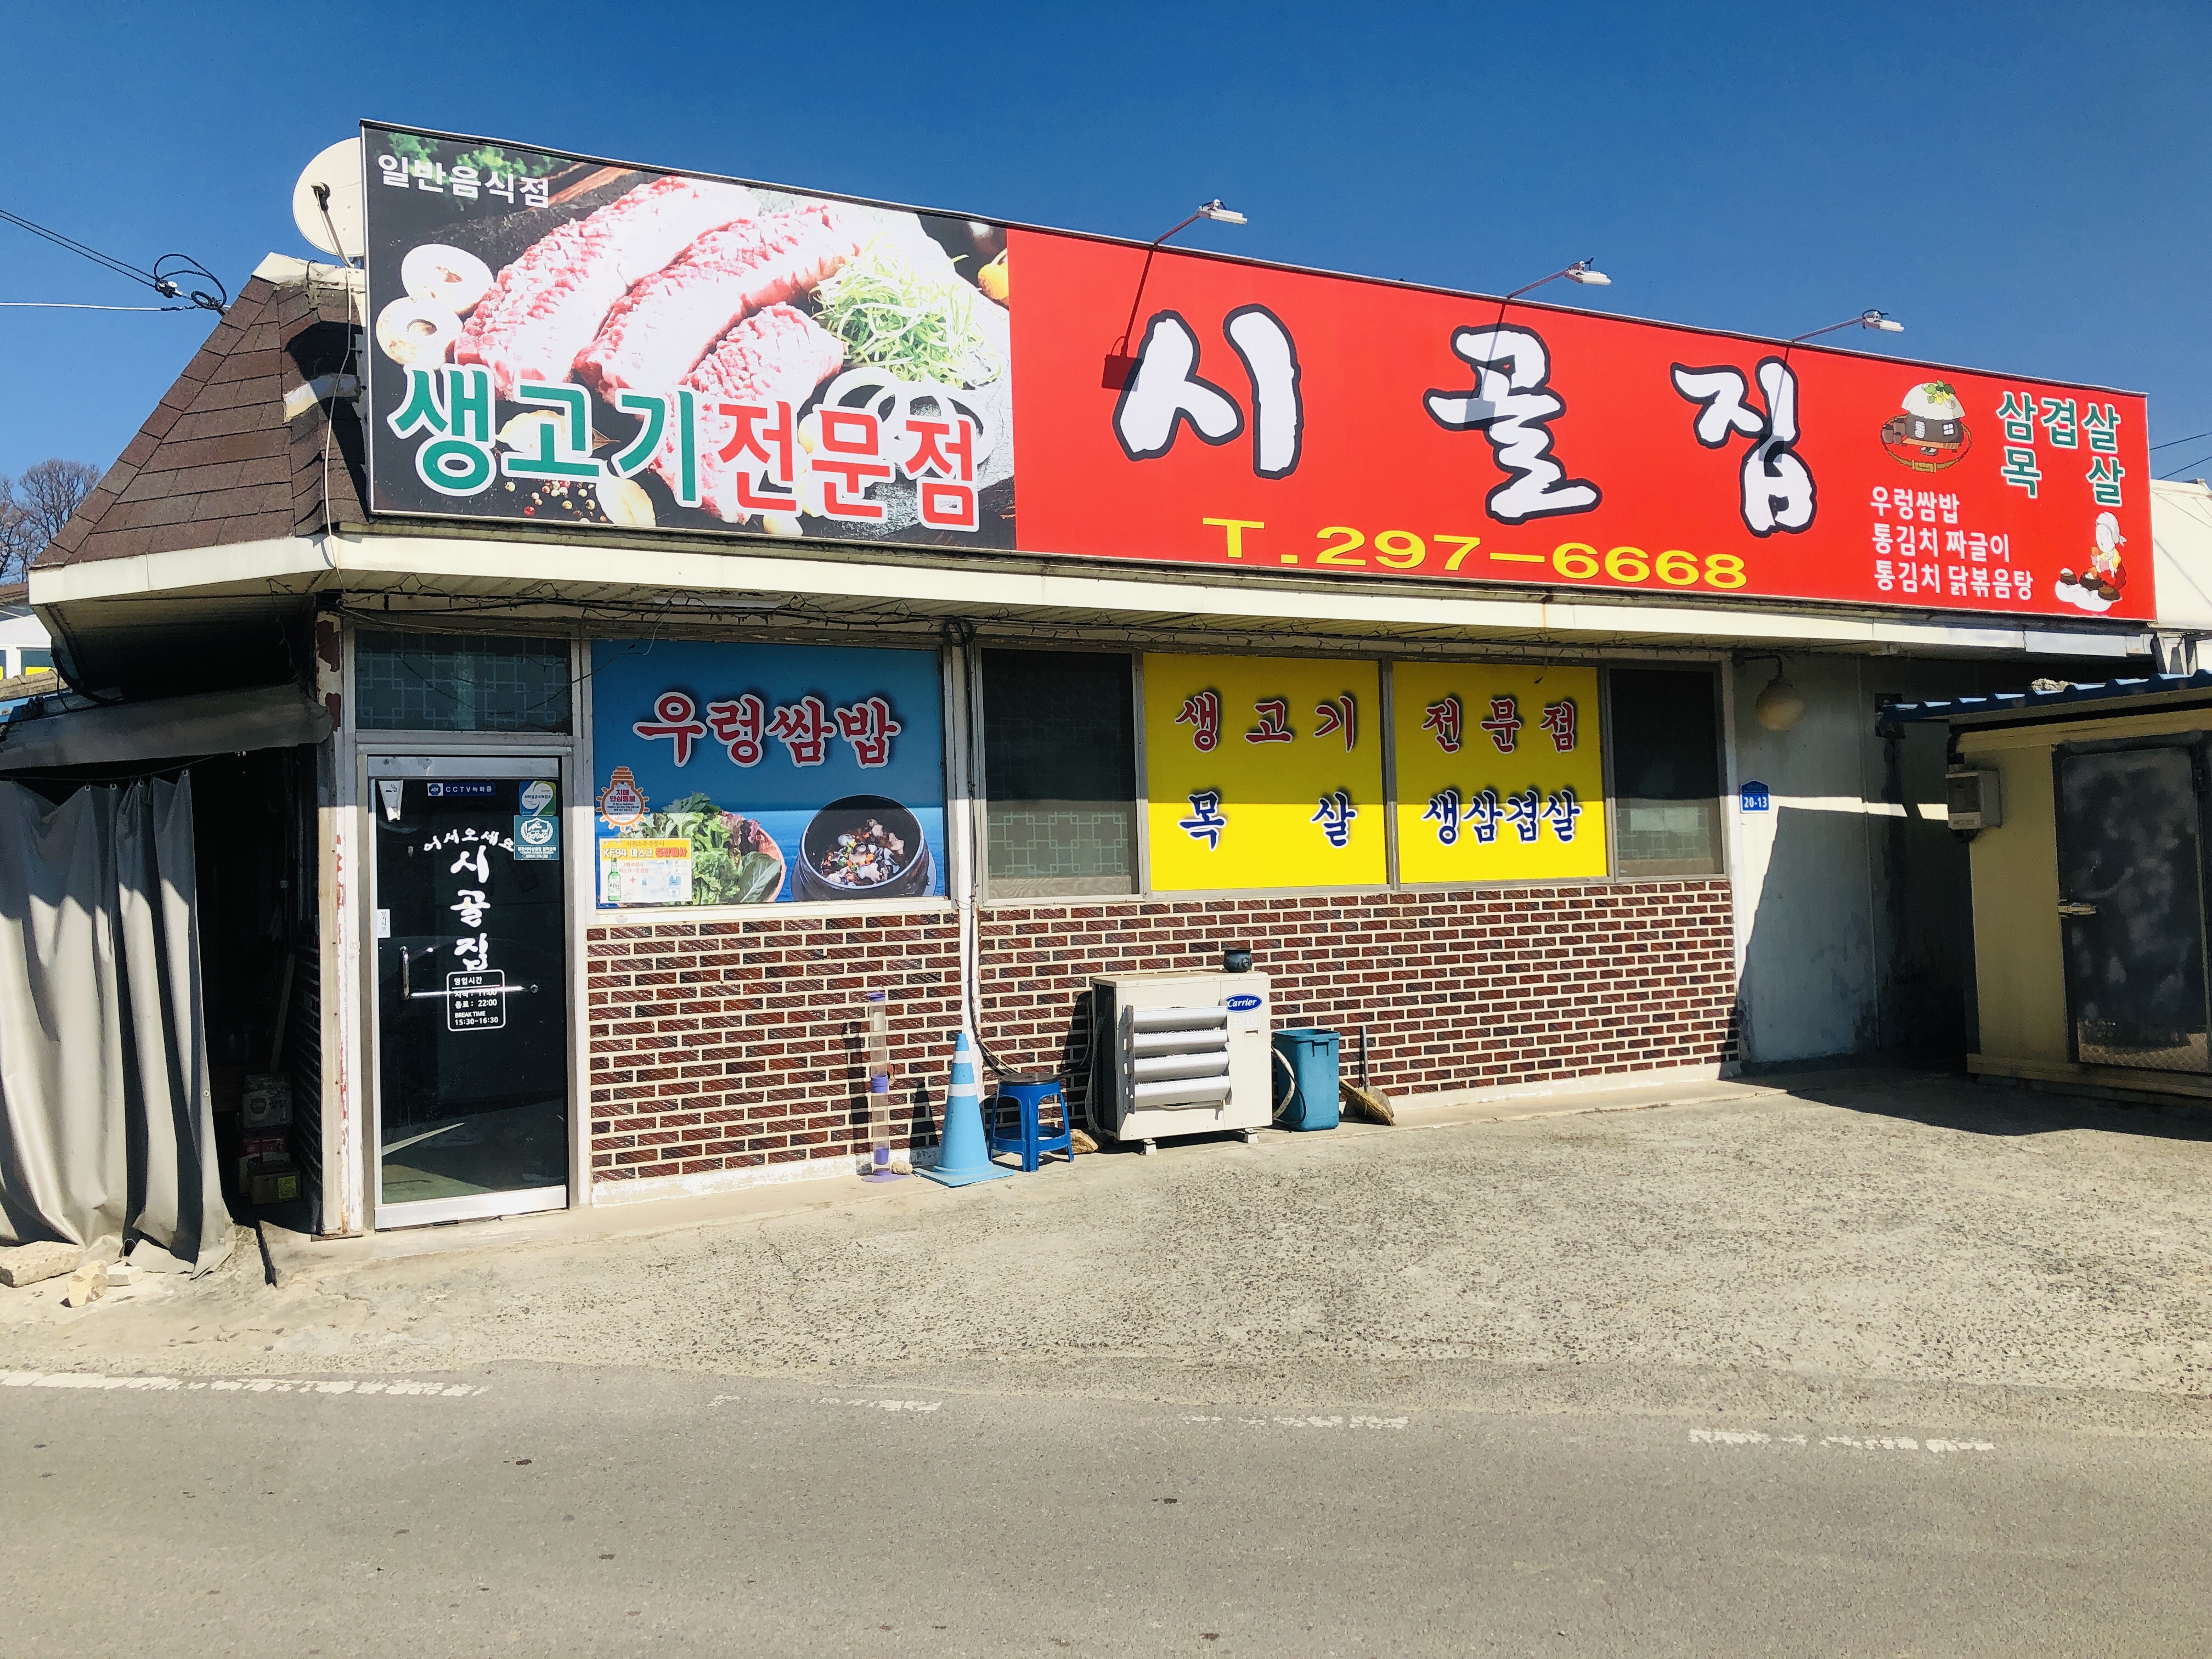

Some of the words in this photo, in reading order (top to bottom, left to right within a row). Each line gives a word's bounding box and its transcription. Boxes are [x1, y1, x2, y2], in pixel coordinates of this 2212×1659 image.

[377, 154, 549, 208] 일반음식점
[1996, 391, 2121, 454] 삼겹살
[1870, 486, 1960, 524] 우렁쌈밥
[1872, 523, 1938, 557] 통김치
[1946, 530, 2010, 563] 짜글이
[1874, 560, 1940, 594] 통김치
[1948, 565, 2034, 600] 닭볶음탕
[633, 692, 901, 769] 우렁쌈밥
[1421, 789, 1582, 846] 생삼겹살
[1744, 797, 1767, 808] 20-13
[424, 828, 514, 851] 어서오세요
[603, 848, 627, 858] KF94
[629, 848, 653, 858] 마스크
[454, 976, 482, 985] 영업시간
[478, 998, 498, 1007] 22:00
[1228, 998, 1257, 1007] Carrier
[455, 1016, 499, 1026] 15:30-16:30
